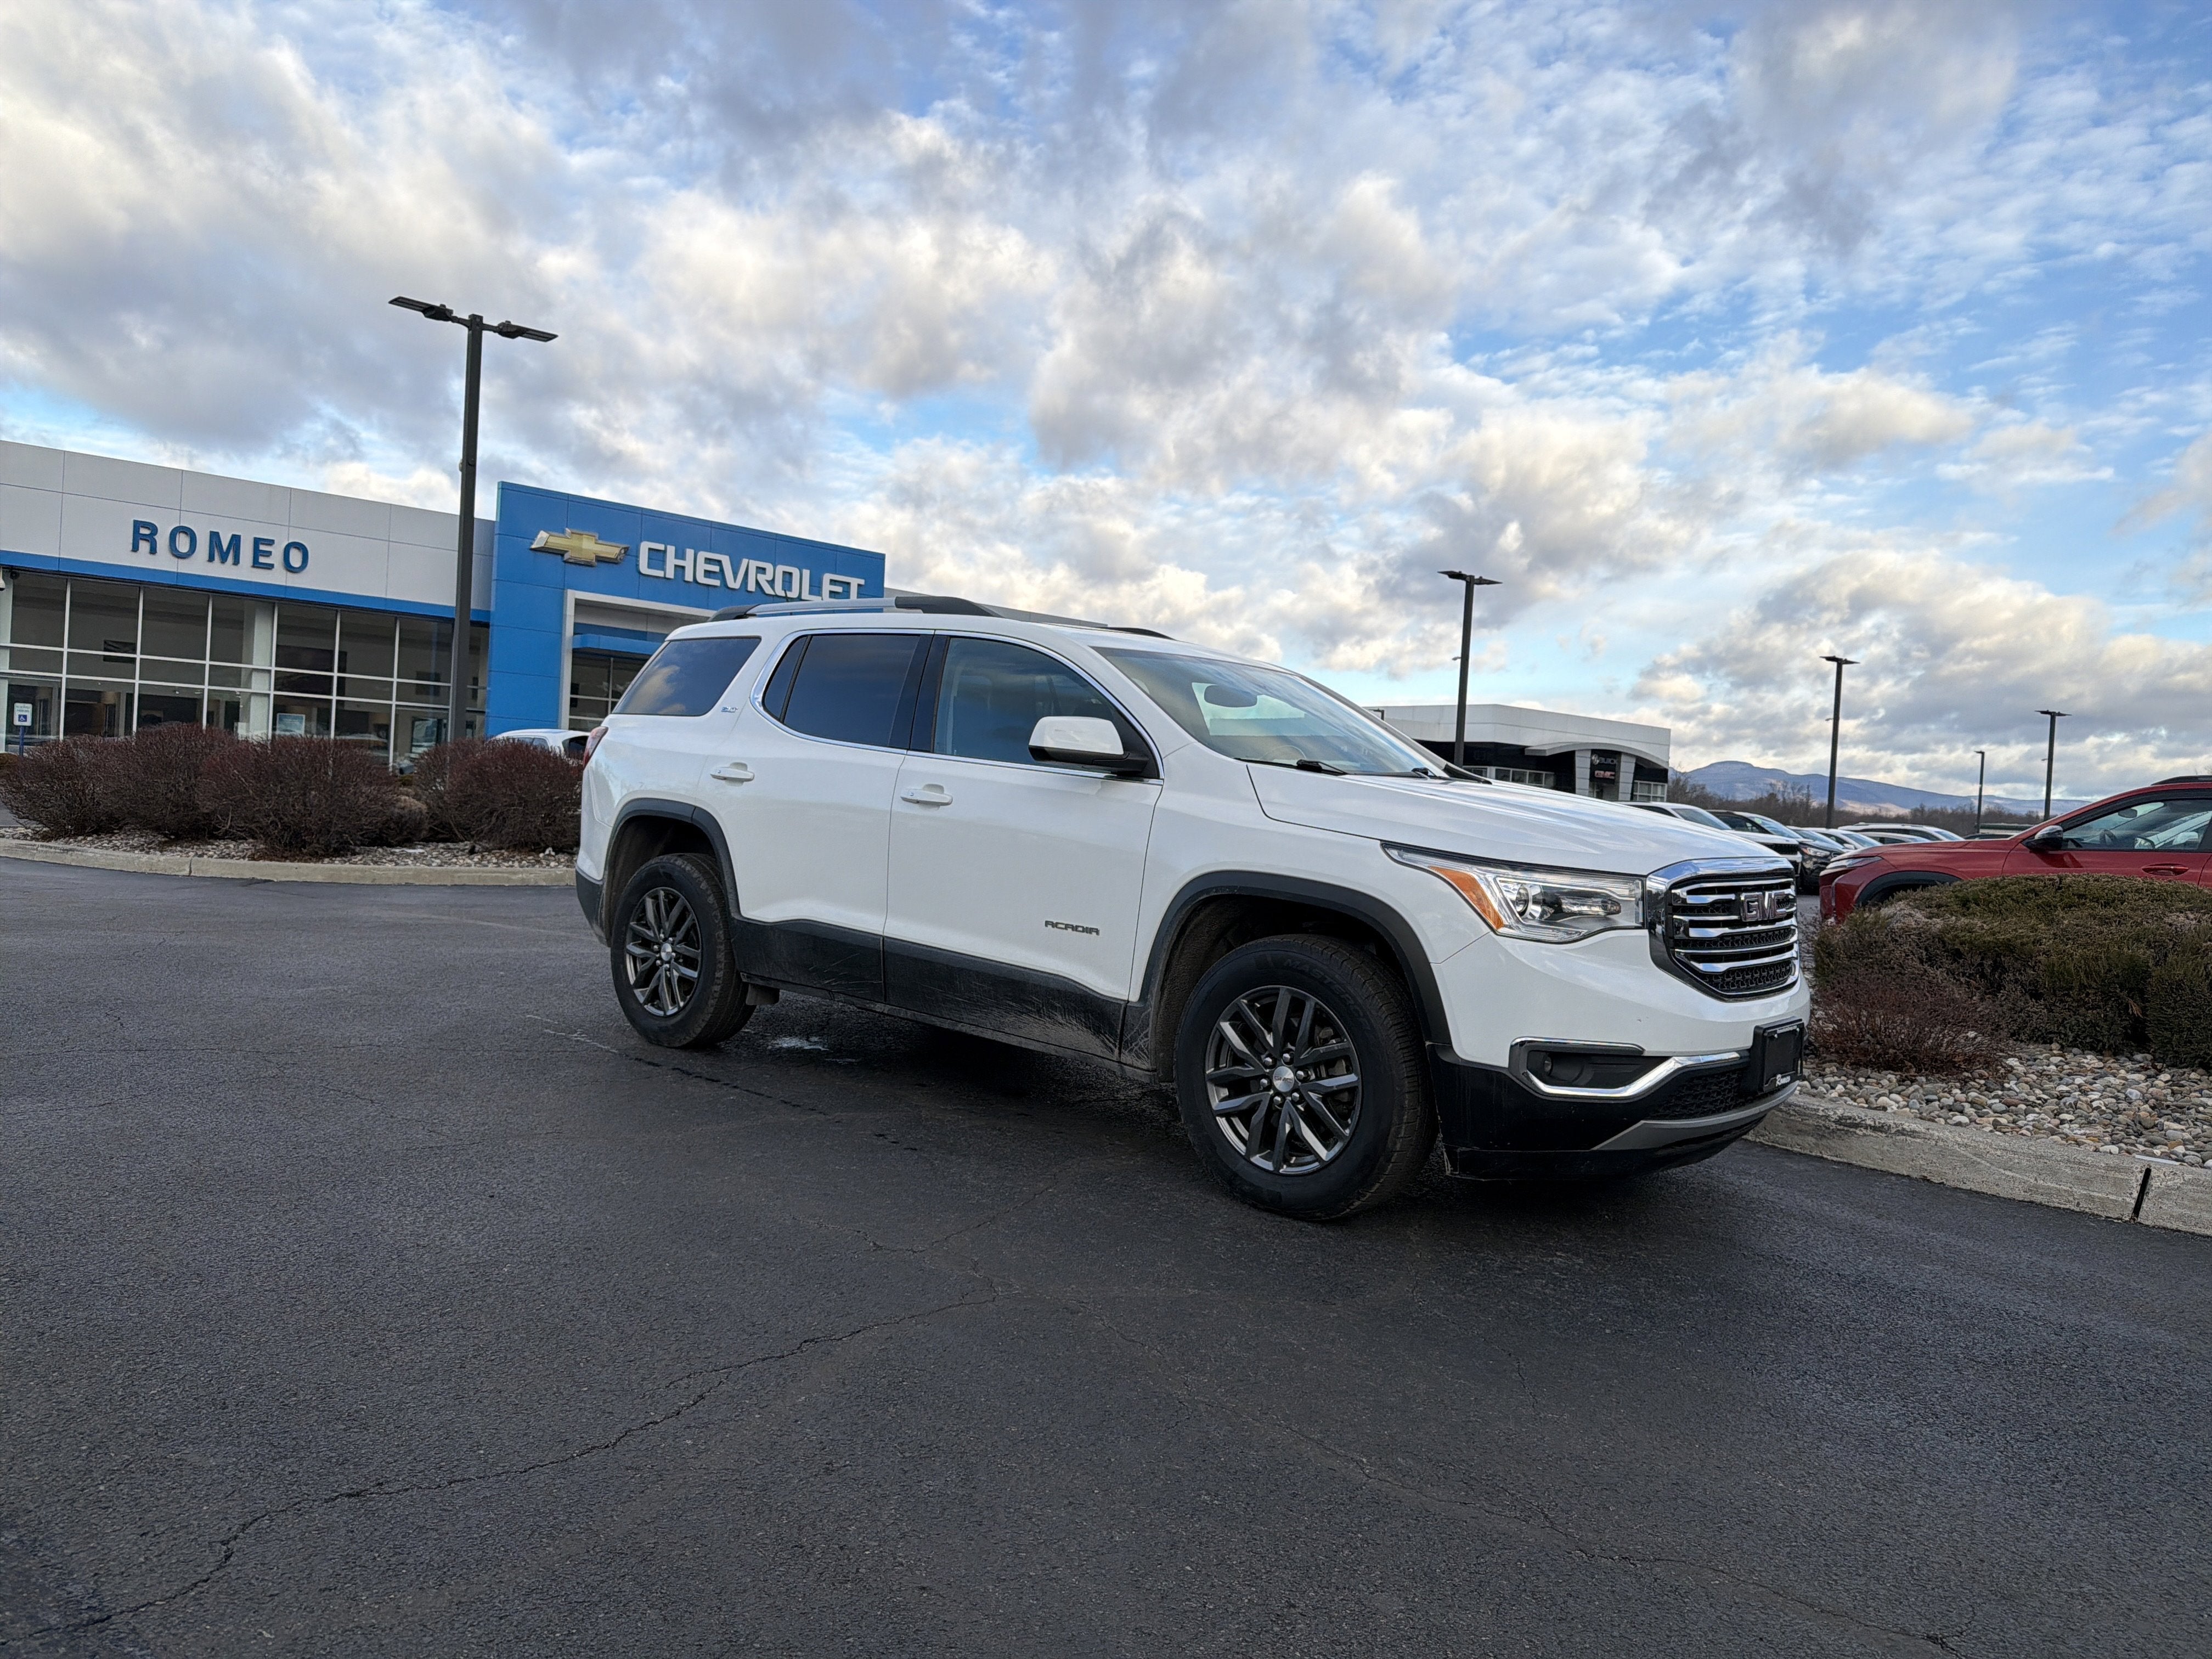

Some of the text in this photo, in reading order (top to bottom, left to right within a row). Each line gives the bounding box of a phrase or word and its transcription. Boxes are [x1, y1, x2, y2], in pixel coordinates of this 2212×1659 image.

[131, 519, 309, 573] ROMEO
[639, 541, 865, 601] CHEVROLET
[1595, 770, 1615, 778] GMC
[1740, 891, 1787, 922] GMC
[1045, 921, 1099, 935] ACADIA
